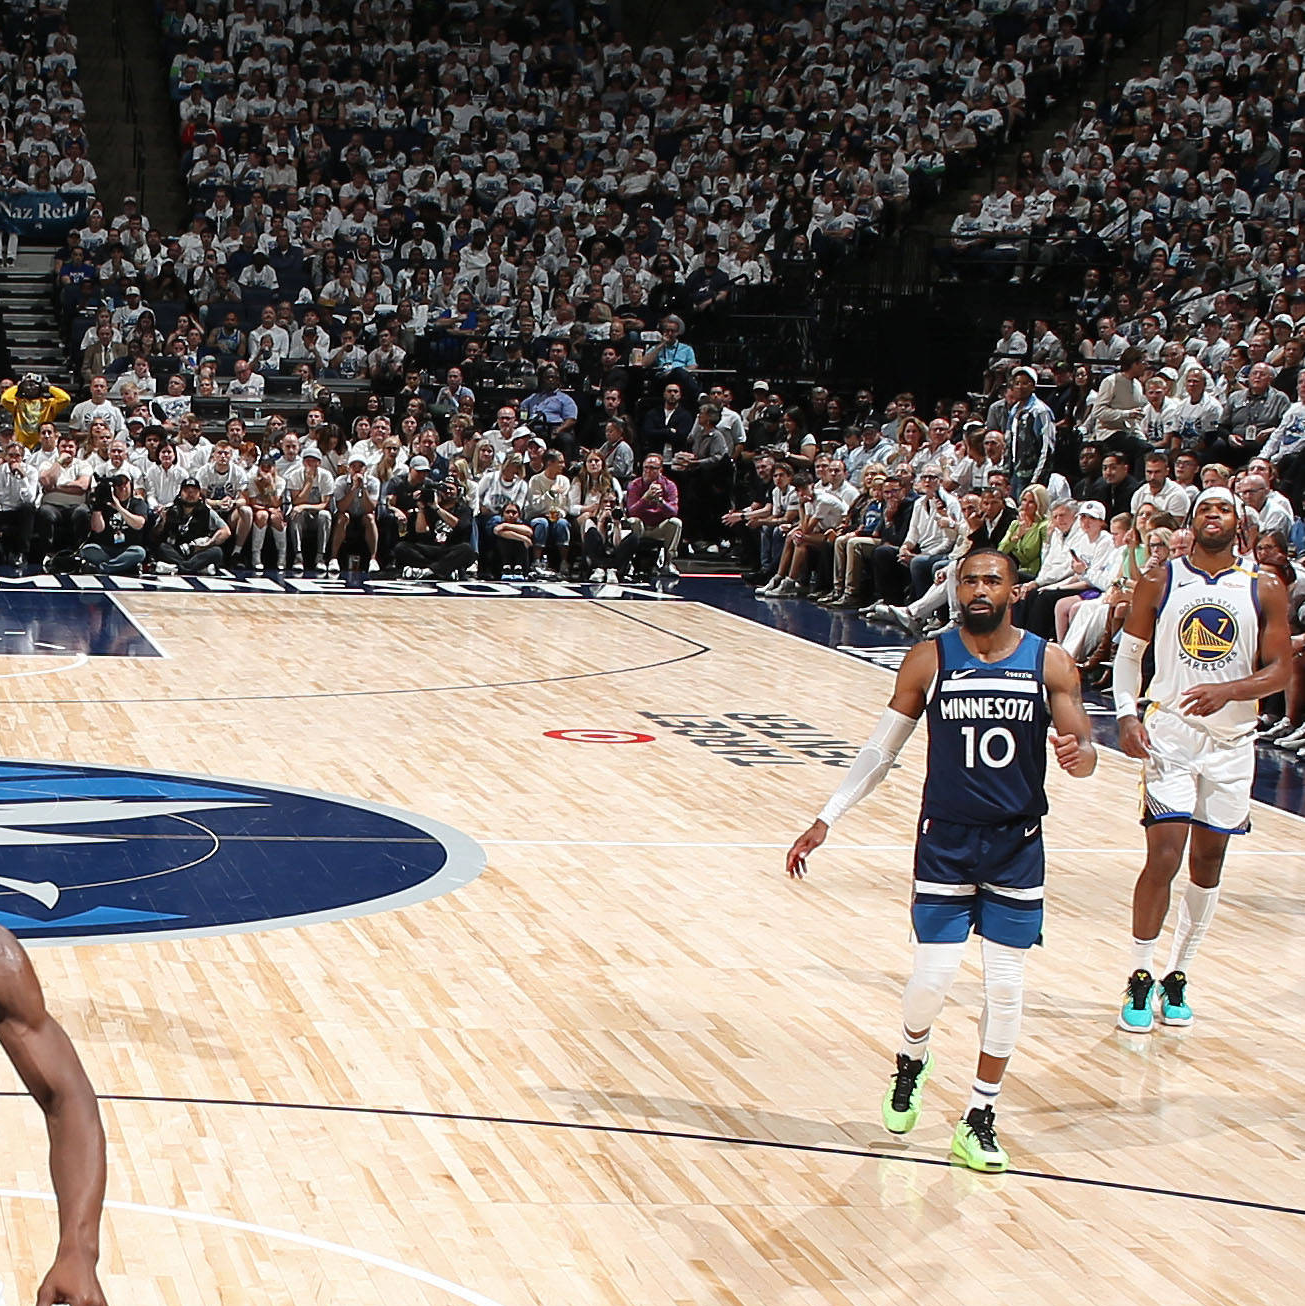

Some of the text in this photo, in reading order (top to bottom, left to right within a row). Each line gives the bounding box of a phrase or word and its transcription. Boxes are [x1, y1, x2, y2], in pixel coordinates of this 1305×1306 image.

[38, 201, 79, 219] Reid
[1217, 617, 1230, 636] 7
[1178, 649, 1239, 672] WARRIORS
[940, 697, 1034, 722] MINNESOTA
[636, 711, 806, 767] TARGET
[961, 726, 1016, 768] 10
